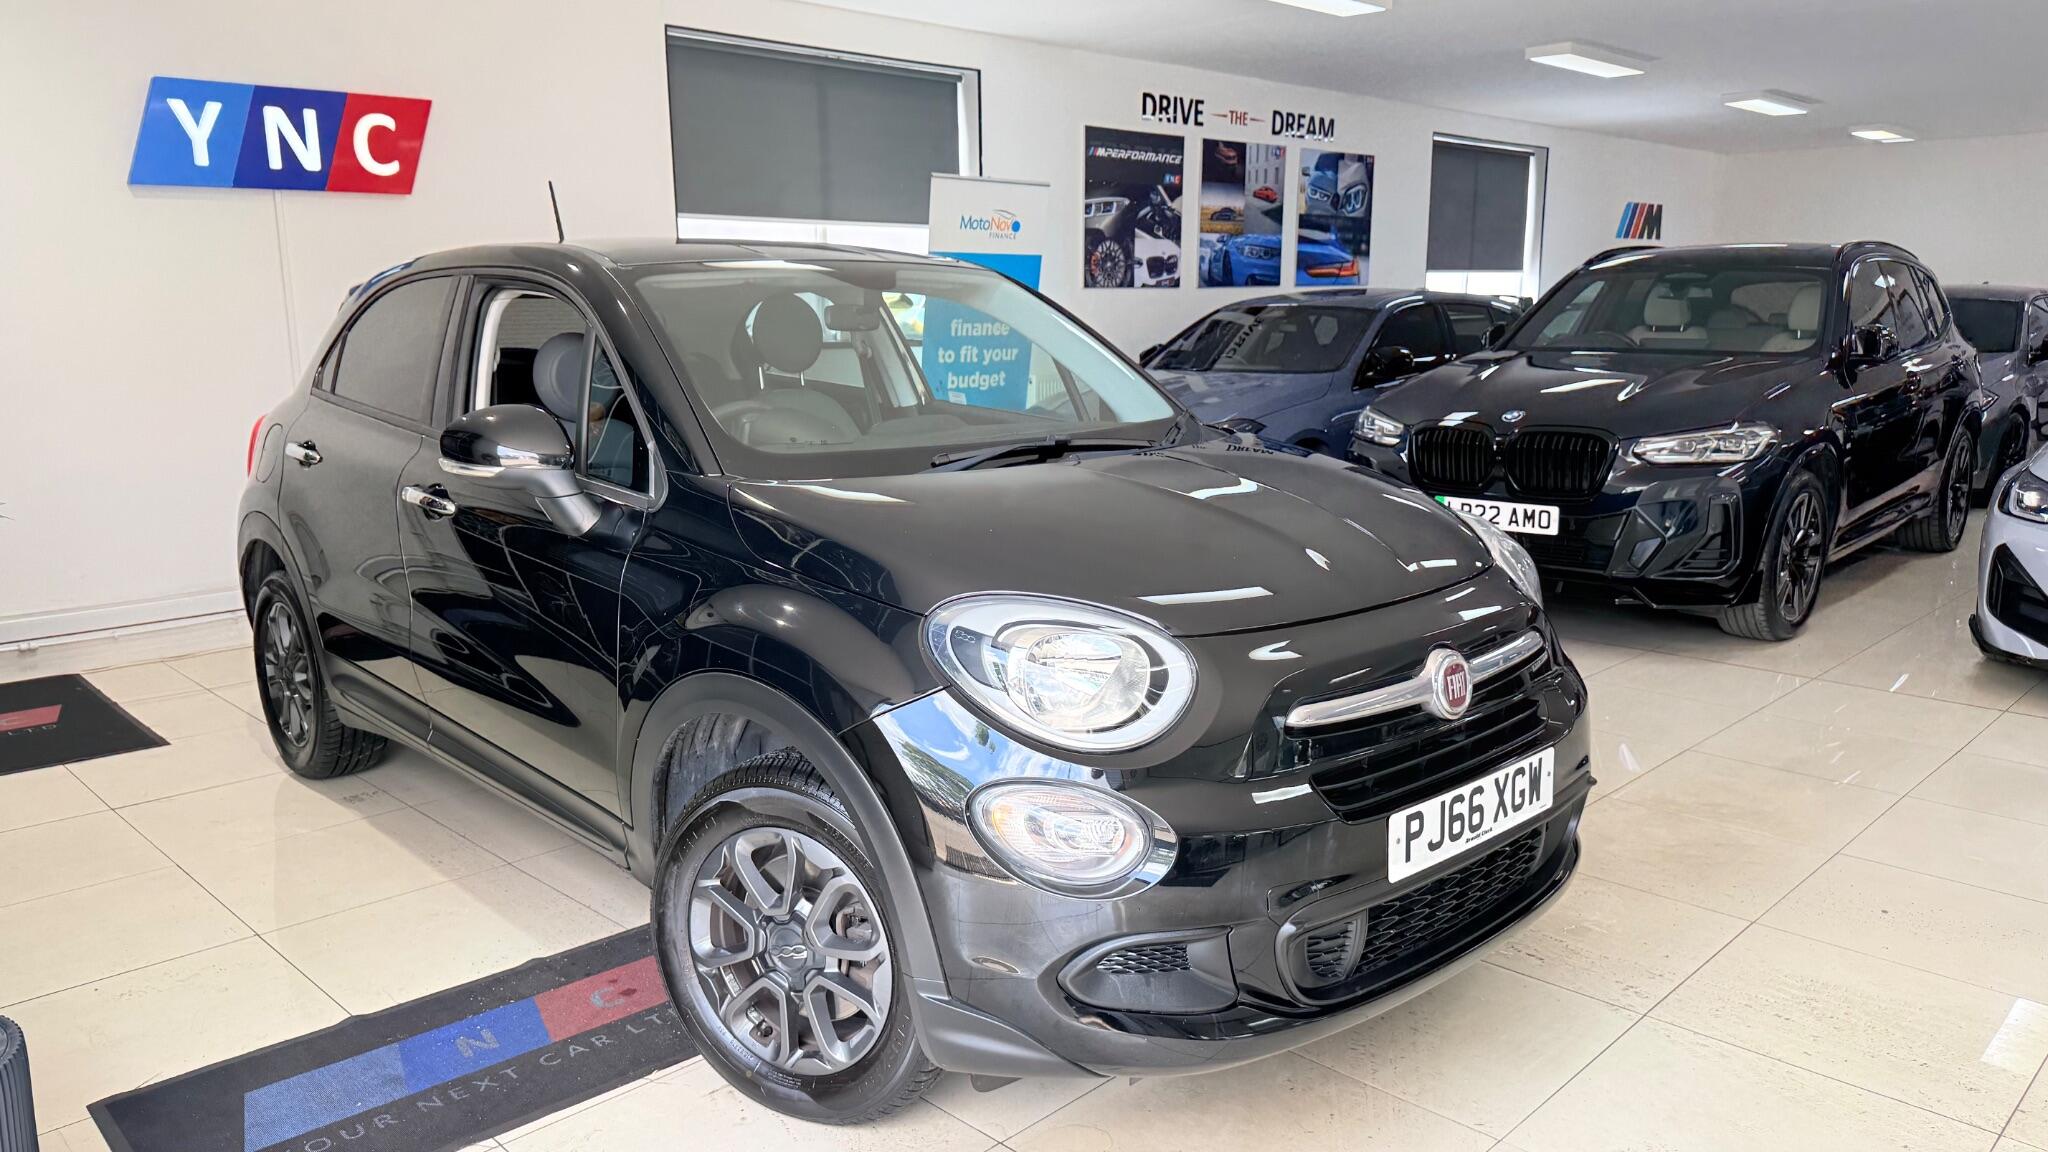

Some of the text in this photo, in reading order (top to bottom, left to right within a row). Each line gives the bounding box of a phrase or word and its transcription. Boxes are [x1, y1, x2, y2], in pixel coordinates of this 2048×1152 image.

[1141, 92, 1336, 142] DRIVE THE DREAM
[165, 97, 401, 177] YNC
[989, 232, 1017, 240] FINANCE
[950, 319, 1010, 337] finance
[937, 345, 1020, 366] to fit your
[947, 370, 1006, 391] budget
[1447, 500, 1551, 530] 22 AMO
[1446, 671, 1466, 701] FIAT
[1404, 757, 1543, 864] PJ66 XGW
[285, 1113, 399, 1152] OUR
[415, 1065, 519, 1113] NEXT
[538, 1034, 614, 1067] CAR
